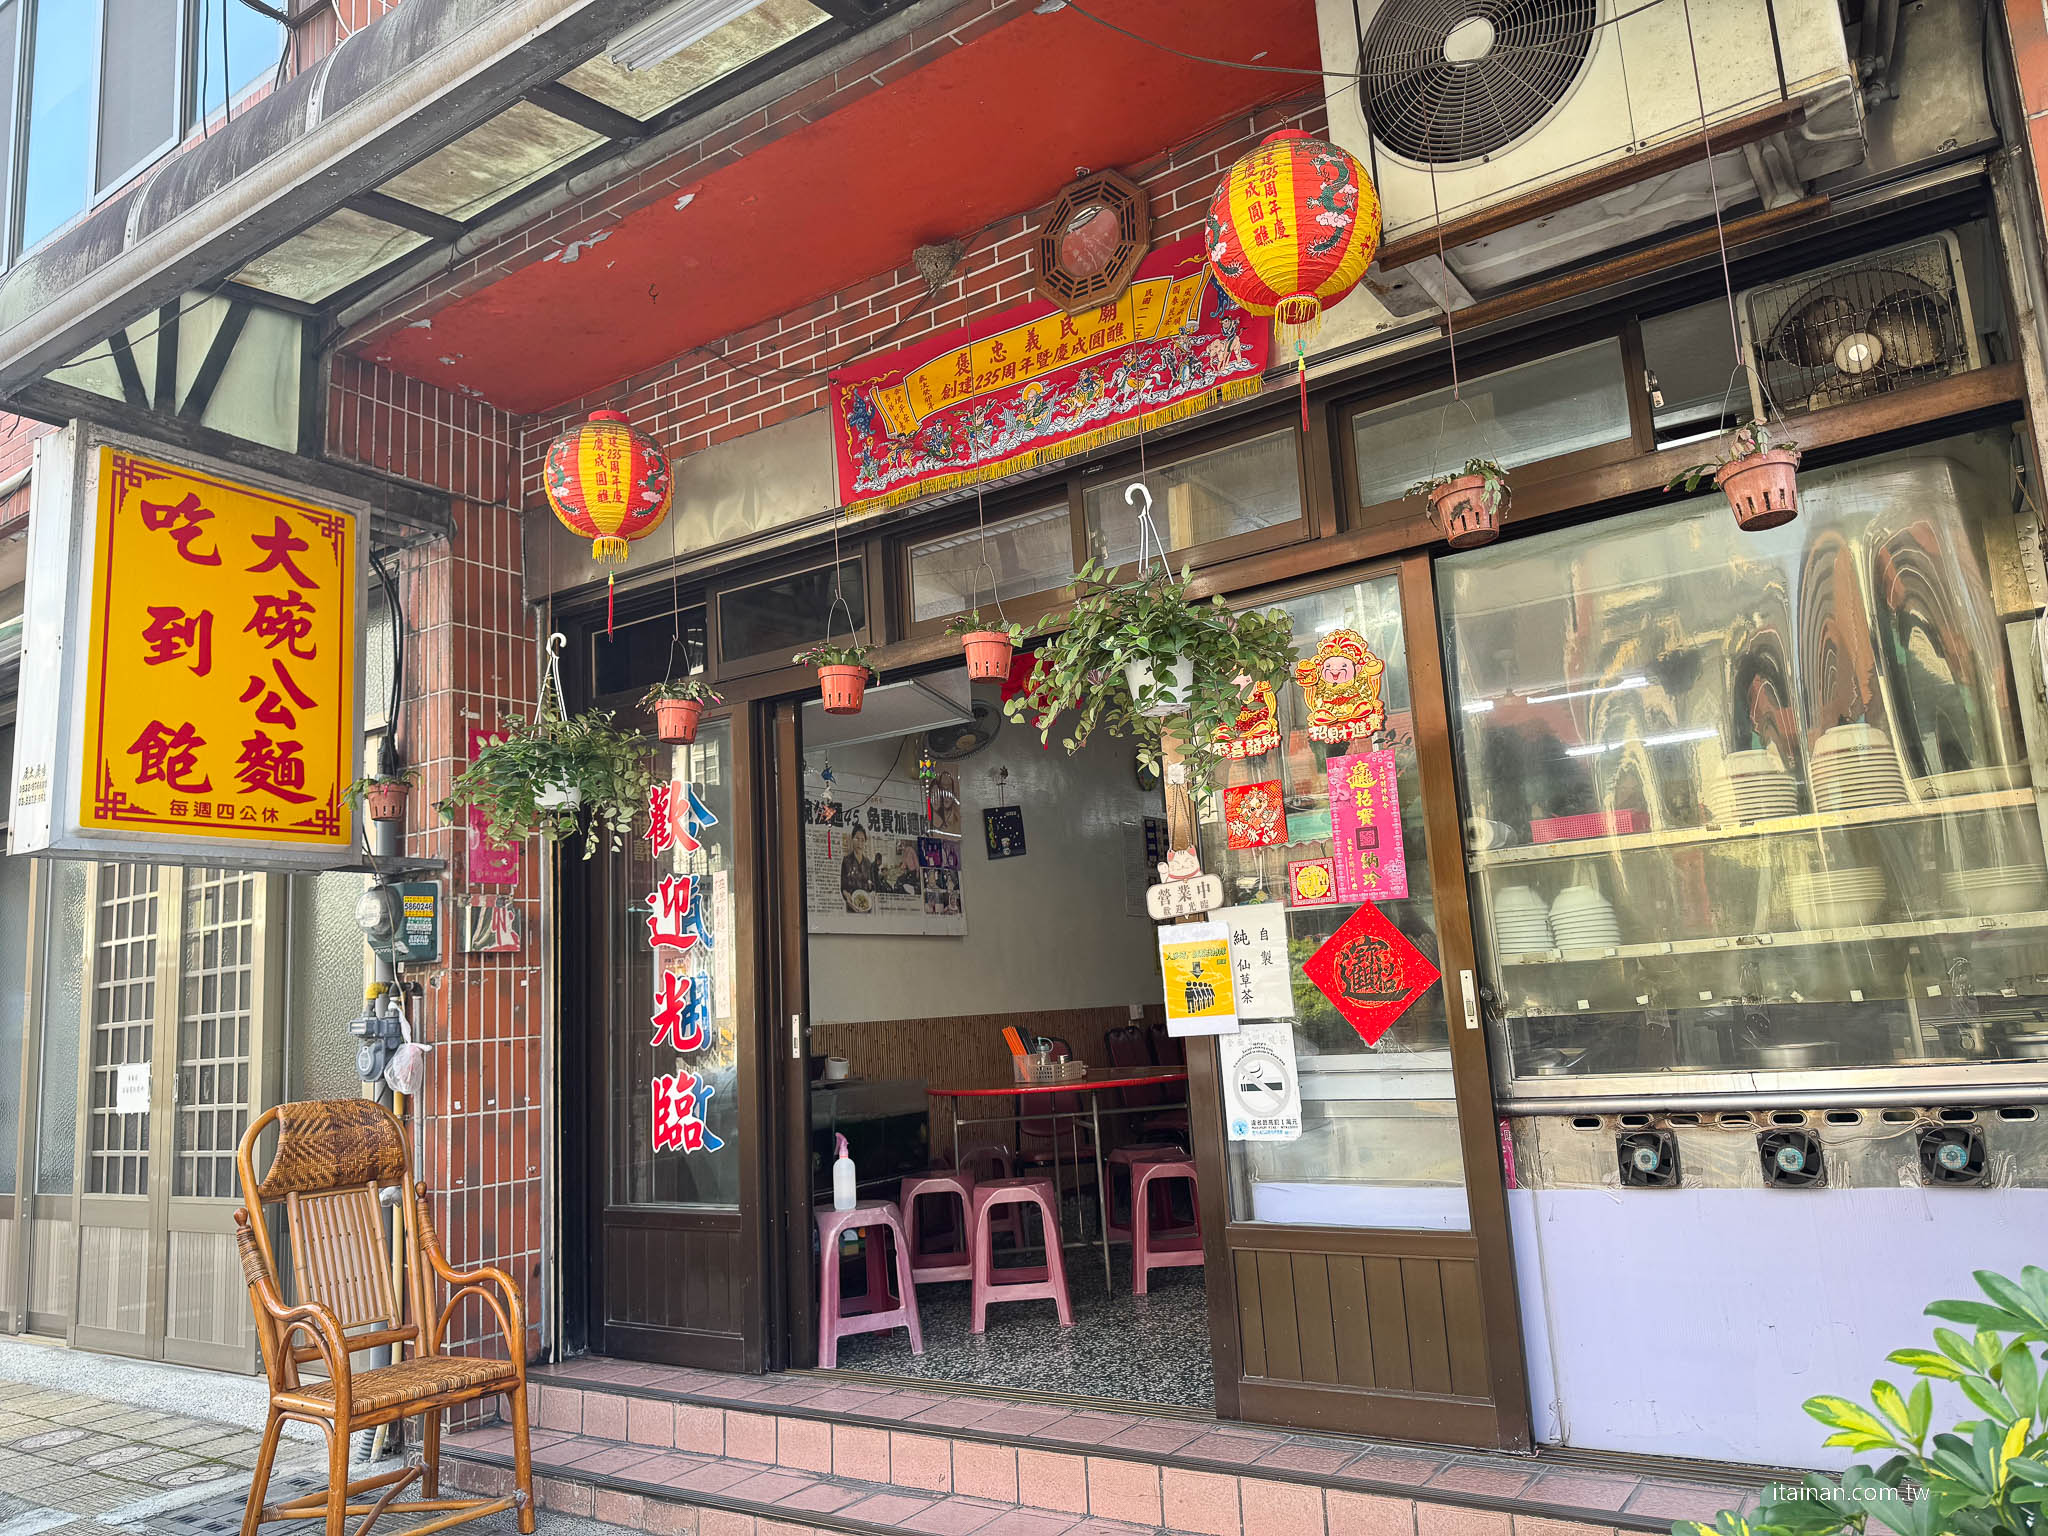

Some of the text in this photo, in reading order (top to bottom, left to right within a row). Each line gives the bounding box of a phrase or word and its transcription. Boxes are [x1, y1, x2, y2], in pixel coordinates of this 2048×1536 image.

[941, 322, 1127, 401] 創建235周年暨慶成圓醮
[955, 302, 1118, 379] 褒忠義民廟
[127, 492, 222, 794] 吃到飽
[235, 515, 321, 803] 大碗公麵
[169, 799, 280, 824] 每週四公休
[1158, 881, 1211, 906] 營業中
[1163, 899, 1209, 916] 歡迎光臨
[643, 781, 702, 1153] 歡迎光臨
[1259, 927, 1274, 967] 自製
